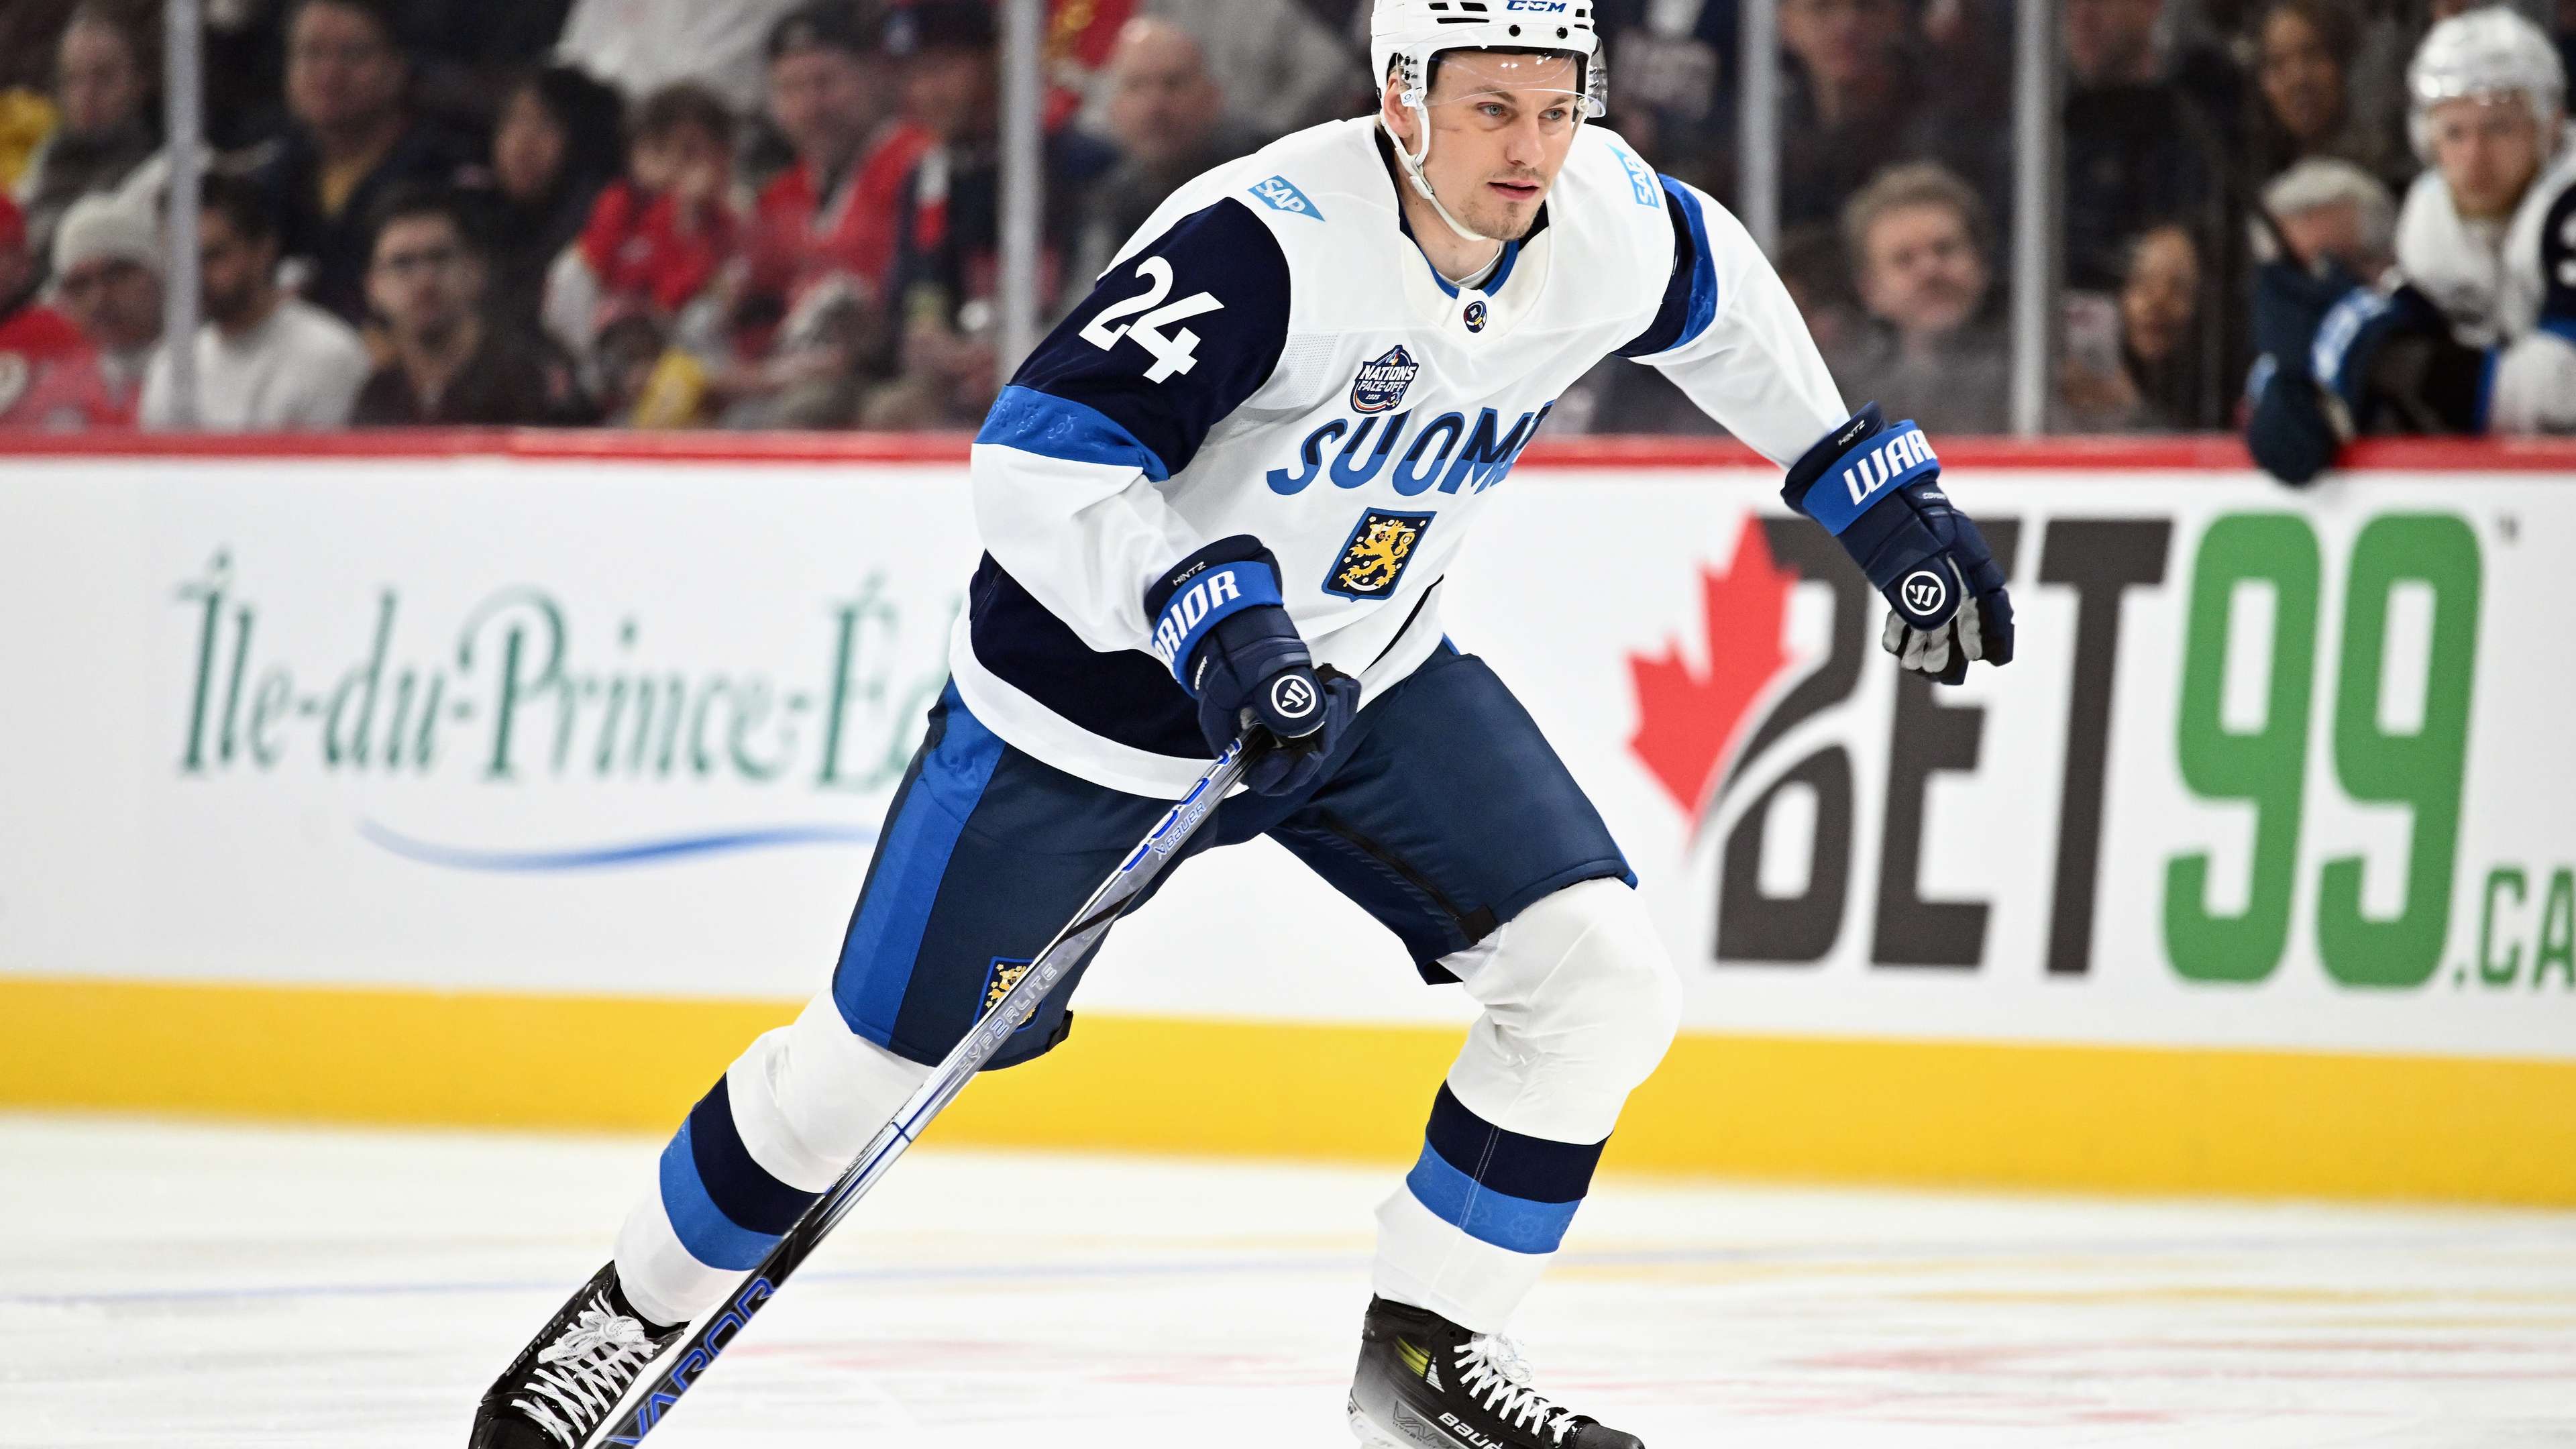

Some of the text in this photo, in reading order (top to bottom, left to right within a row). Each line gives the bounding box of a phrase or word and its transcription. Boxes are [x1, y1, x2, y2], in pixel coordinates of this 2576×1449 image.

[1507, 0, 1566, 13] CCM
[1255, 178, 1305, 212] SAP
[1623, 157, 1655, 204] SAP
[1078, 256, 1225, 384] 24
[1357, 380, 1406, 392] FACE-OFF
[1358, 365, 1417, 381] NATIONS
[1843, 429, 1938, 506] WAR
[1173, 561, 1206, 587] HINTZ
